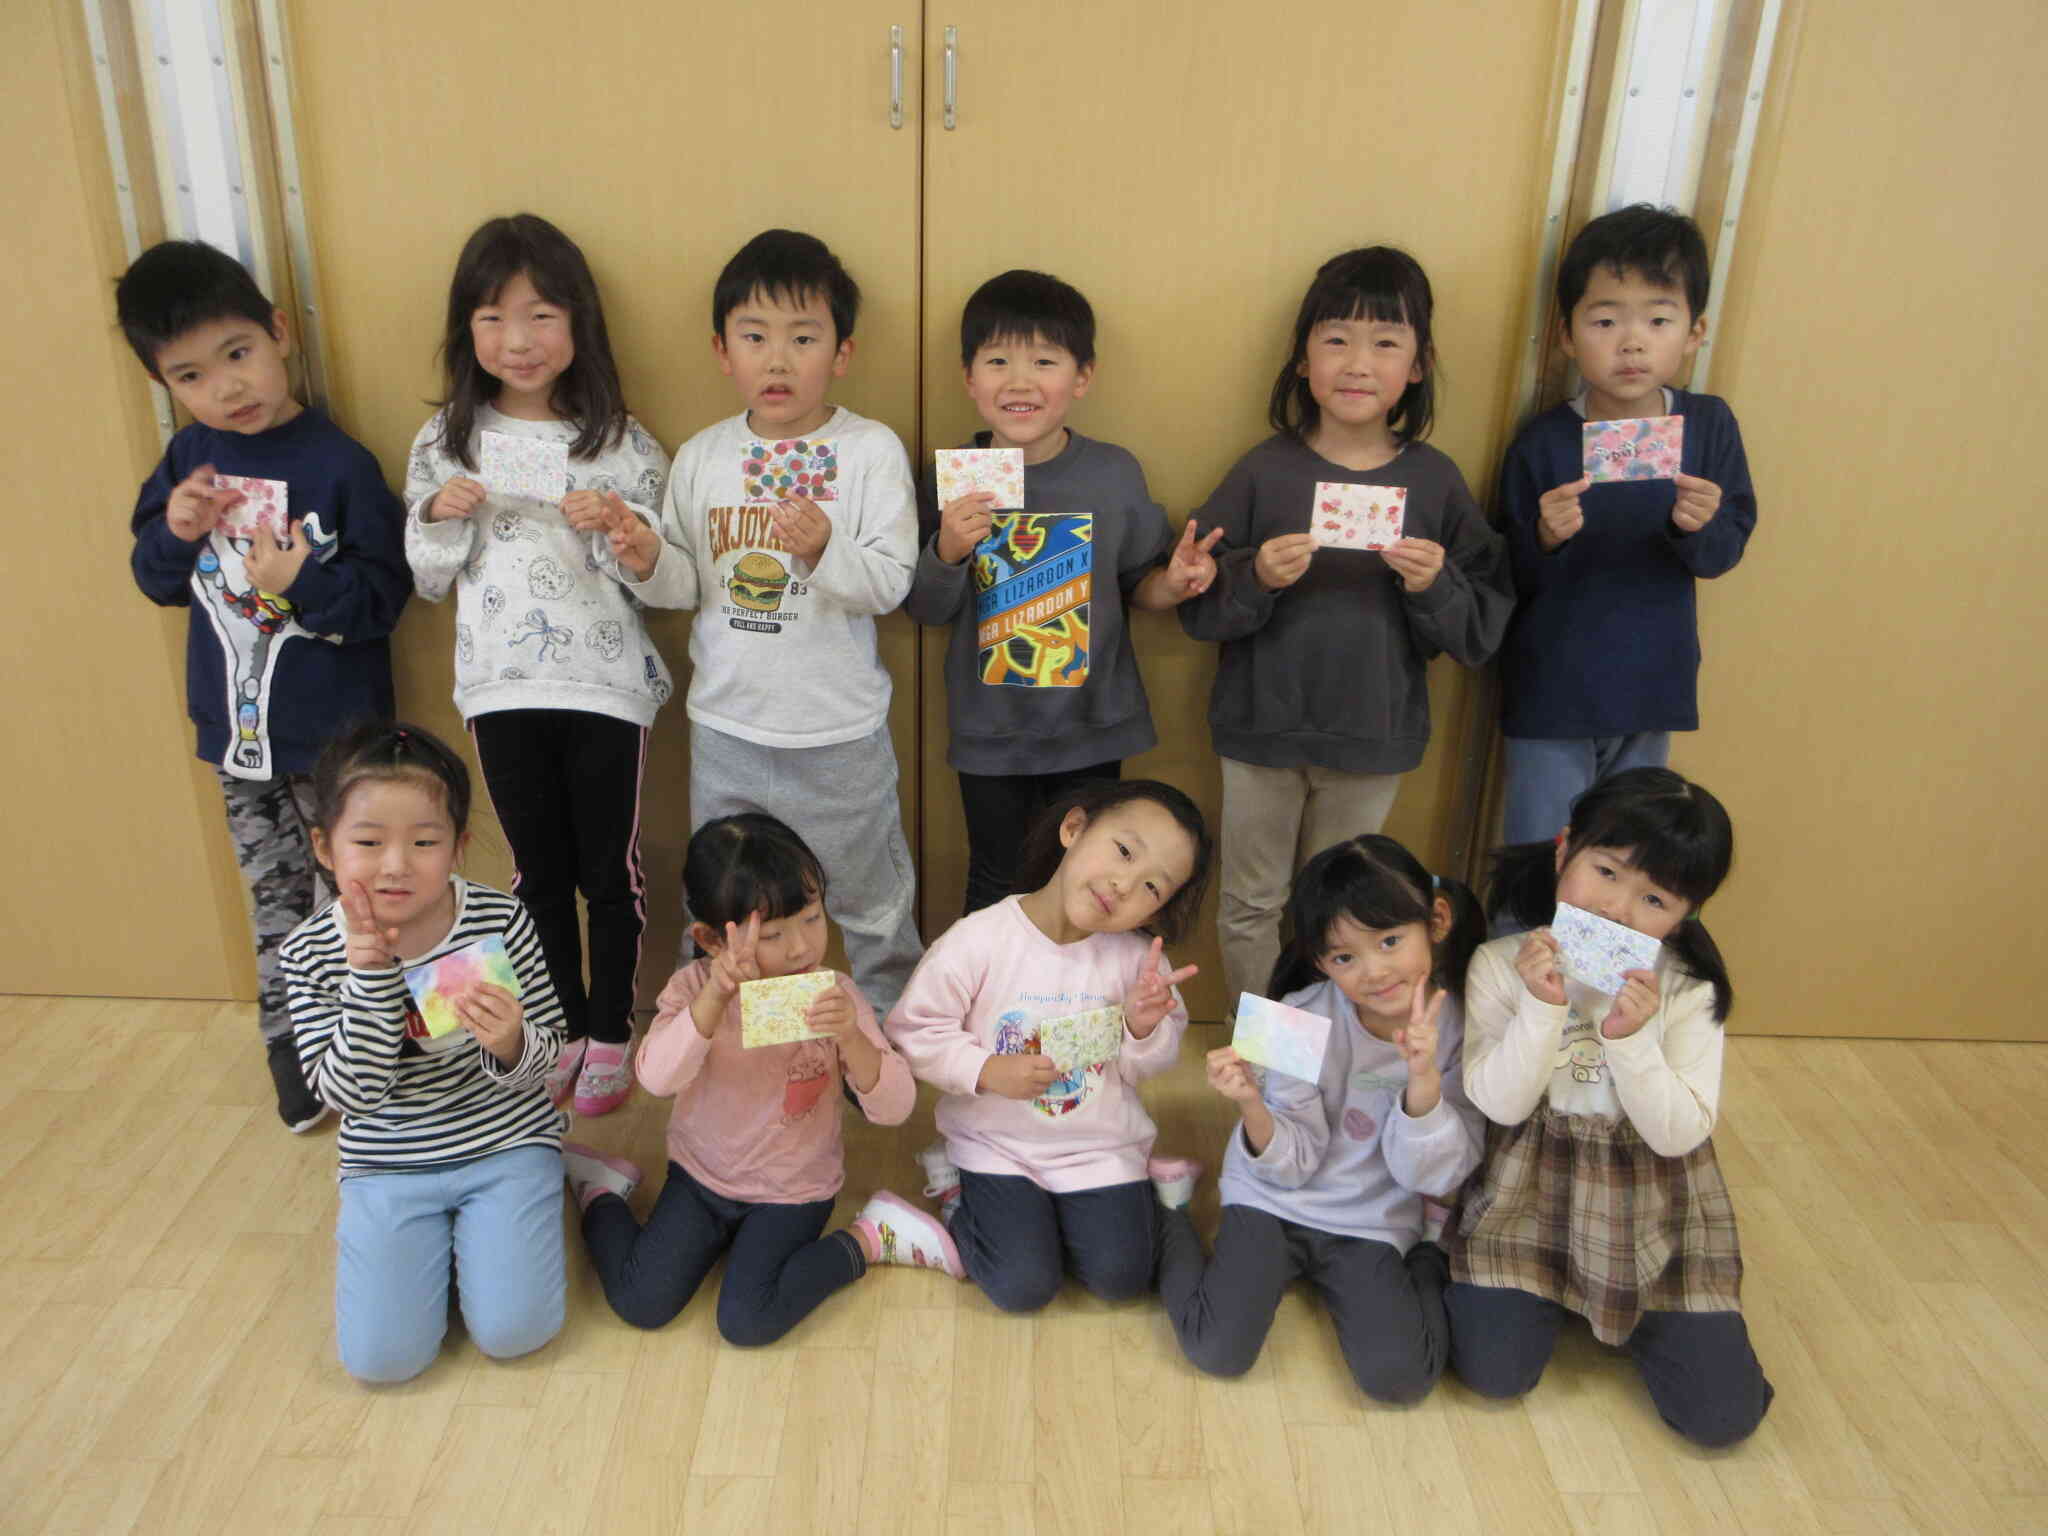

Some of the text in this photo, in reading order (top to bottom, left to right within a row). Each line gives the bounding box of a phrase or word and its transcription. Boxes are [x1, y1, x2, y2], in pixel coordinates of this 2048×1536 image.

[1005, 557, 1073, 604] LIZARDON
[1080, 551, 1089, 567] X
[1005, 587, 1073, 633] LIZARDON
[1080, 580, 1089, 598] Y
